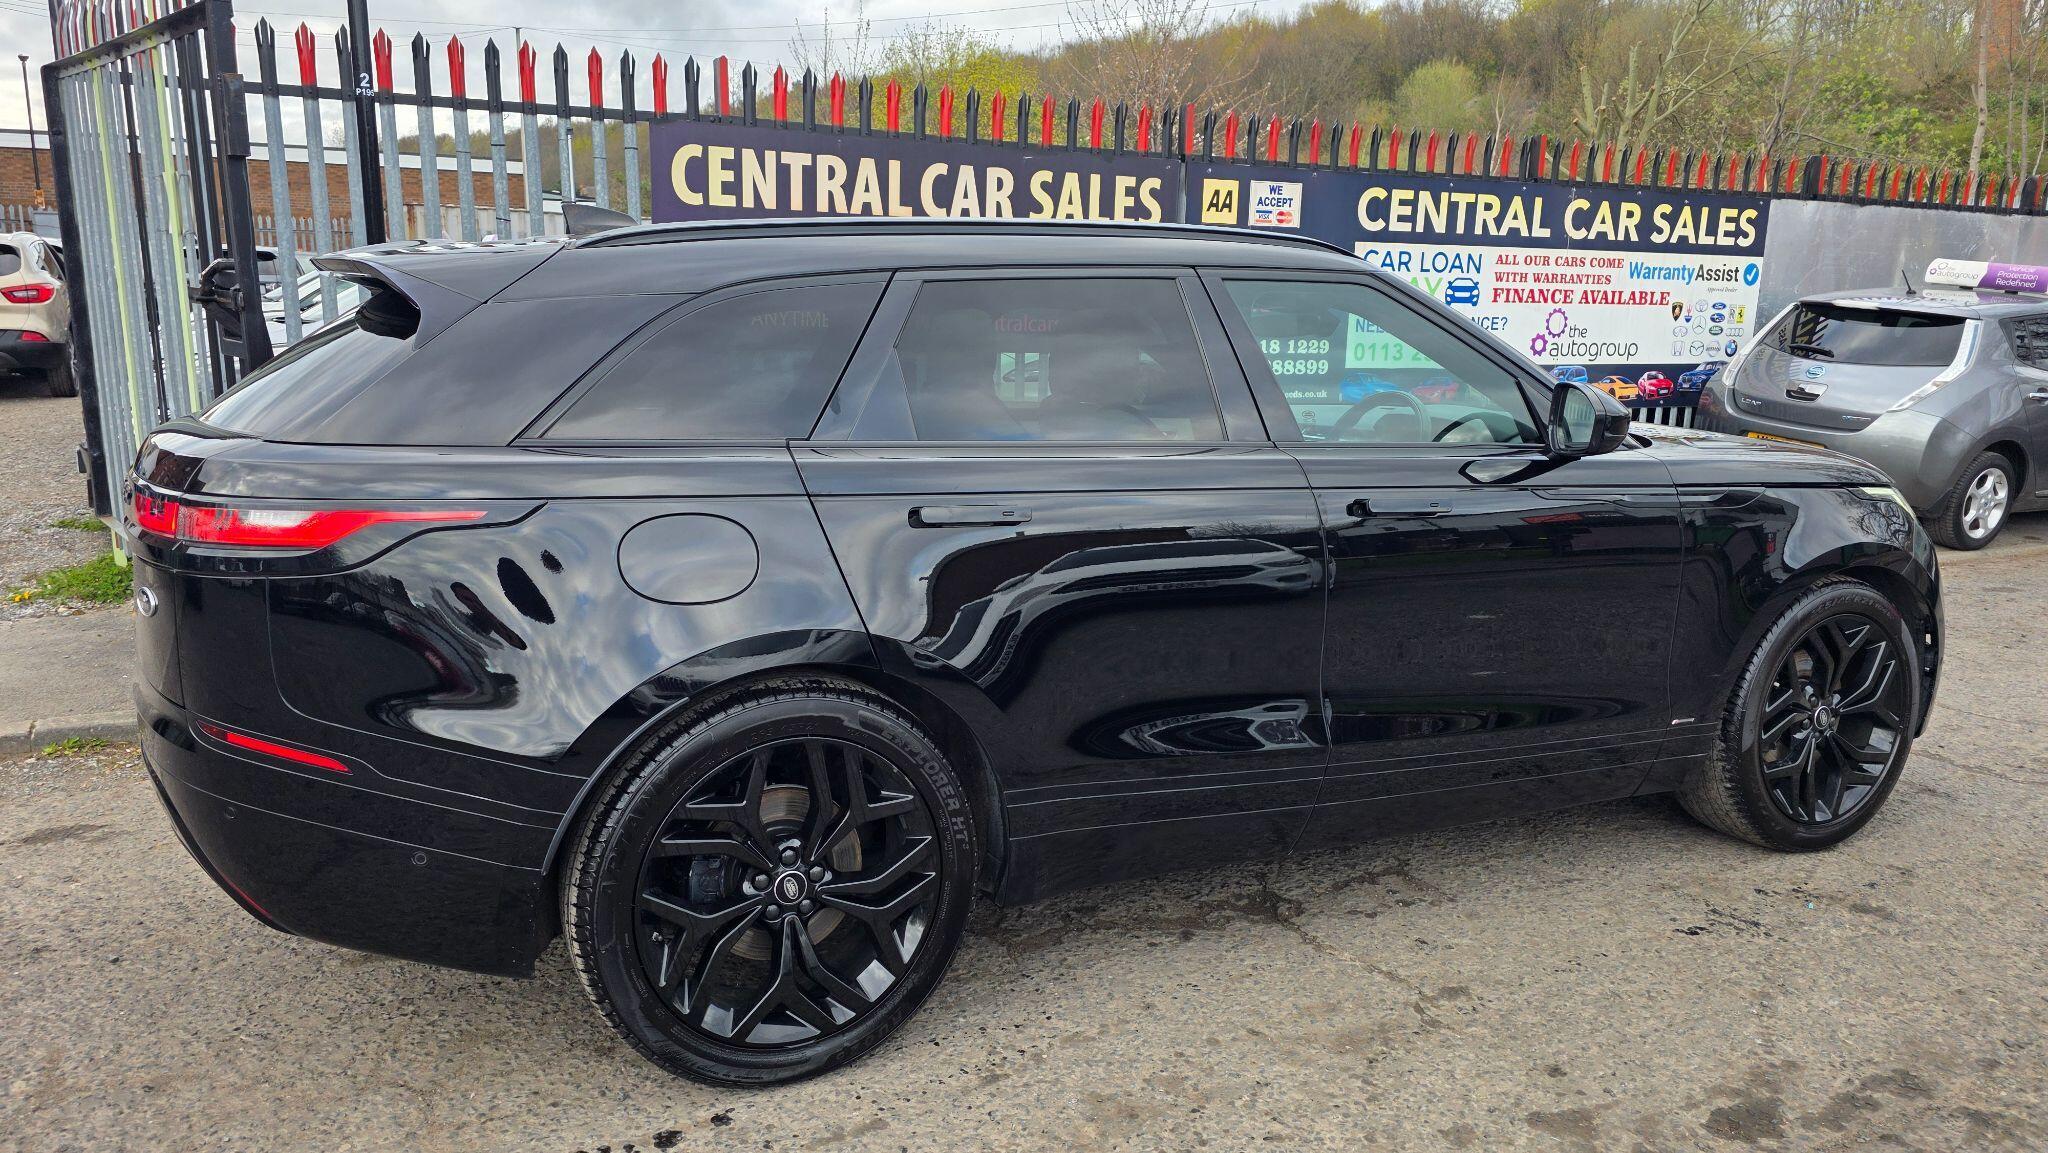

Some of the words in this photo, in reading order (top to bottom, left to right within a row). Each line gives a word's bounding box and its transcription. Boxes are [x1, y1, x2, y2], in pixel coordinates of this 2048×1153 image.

[359, 72, 371, 87] 2
[671, 143, 913, 217] CENTRAL
[920, 162, 1015, 219] CAR
[1029, 169, 1162, 224] SALES
[1268, 184, 1284, 196] WE
[1206, 189, 1233, 213] AA
[1256, 196, 1294, 208] ACCEPT
[1357, 186, 1551, 238] CENTRAL
[1564, 198, 1642, 242] CAR
[1650, 203, 1759, 247] SALES
[1363, 249, 1412, 272] CAR
[1420, 251, 1483, 274] LOAN
[1495, 254, 1520, 266] ALL
[1523, 254, 1551, 267] OUR
[1555, 256, 1587, 268] CARS
[1589, 257, 1625, 269] COME
[1494, 271, 1529, 283] WITH
[1533, 272, 1612, 285] WARRANTIES
[1936, 269, 1979, 280] autogroup
[1997, 270, 2039, 281] Protection
[1995, 278, 2037, 289] Redefined
[1491, 287, 1575, 305] FINANCE
[1578, 289, 1671, 306] AVAILABLE
[1568, 324, 1588, 338] the
[1287, 339, 1330, 354] 1229
[1353, 342, 1404, 361] 0113
[1549, 339, 1639, 361] autogroup
[1267, 359, 1329, 375] 88899
